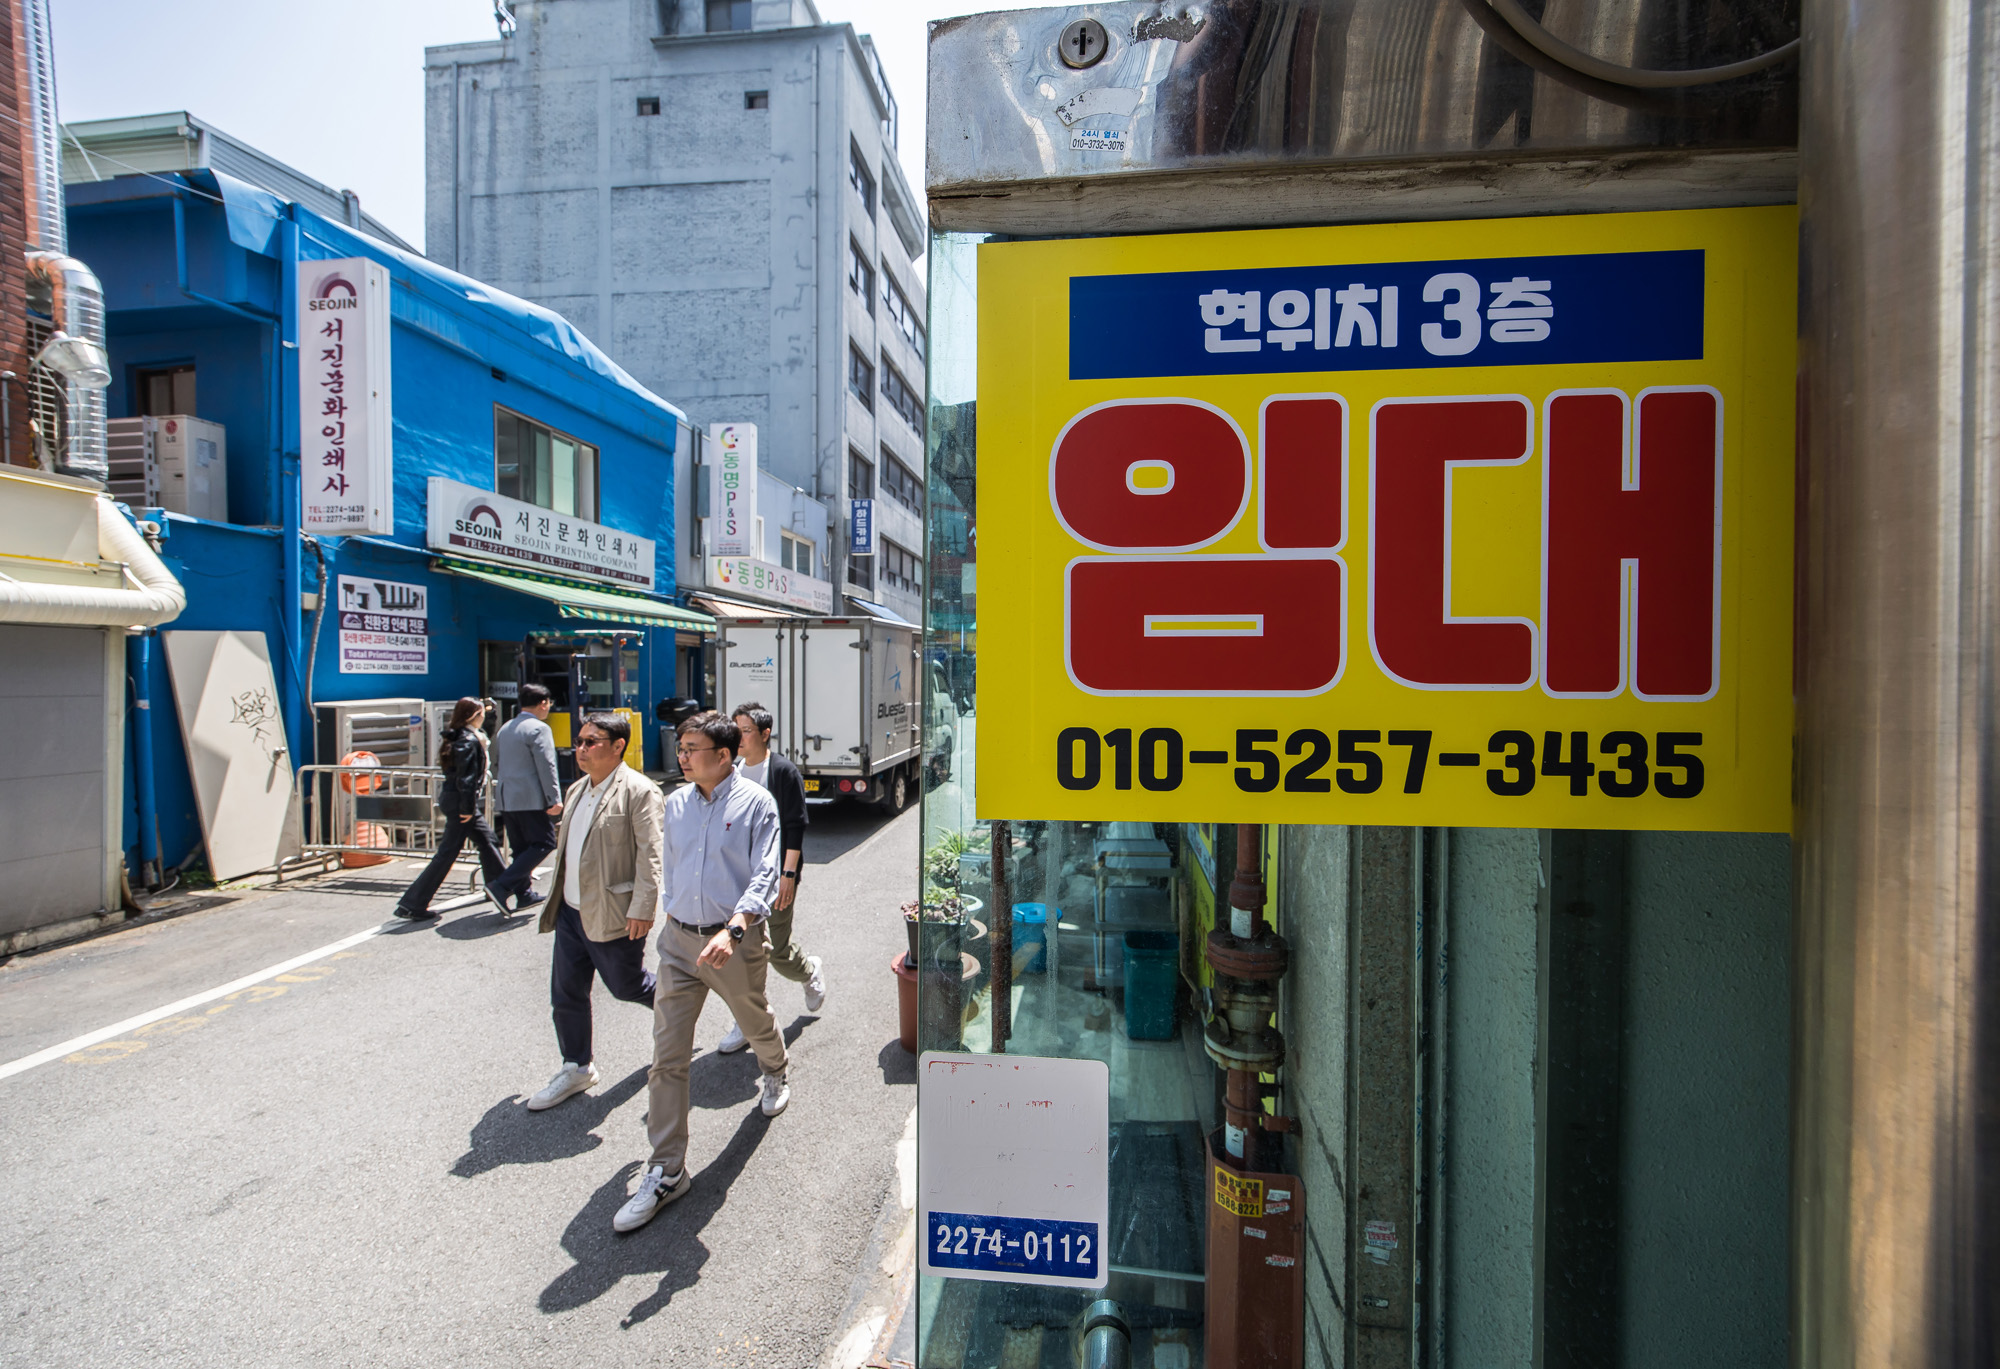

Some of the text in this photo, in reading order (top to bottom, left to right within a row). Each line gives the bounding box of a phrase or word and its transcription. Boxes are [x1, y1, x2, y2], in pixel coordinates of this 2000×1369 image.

[1072, 138, 1125, 151] 010-3732-3076
[1081, 130, 1119, 139] 24시 열쇠
[309, 299, 357, 311] SEOJIN
[1199, 272, 1554, 357] 현위치 3층
[320, 317, 350, 497] 서진문화인쇄사
[455, 519, 502, 540] SEOJIN
[515, 511, 639, 560] 서진문화인쇄사
[514, 533, 639, 571] SEOJIN PRINTING COMPANY
[1048, 384, 1724, 703] 임대
[363, 614, 425, 634] 친환경 인쇄 전문
[348, 650, 423, 661] Total Printing System
[877, 701, 906, 719] Bluesta
[1056, 727, 1704, 799] 010-5257-3435
[1217, 1191, 1260, 1215] 1588-8221
[936, 1224, 1091, 1265] 2274-0112
